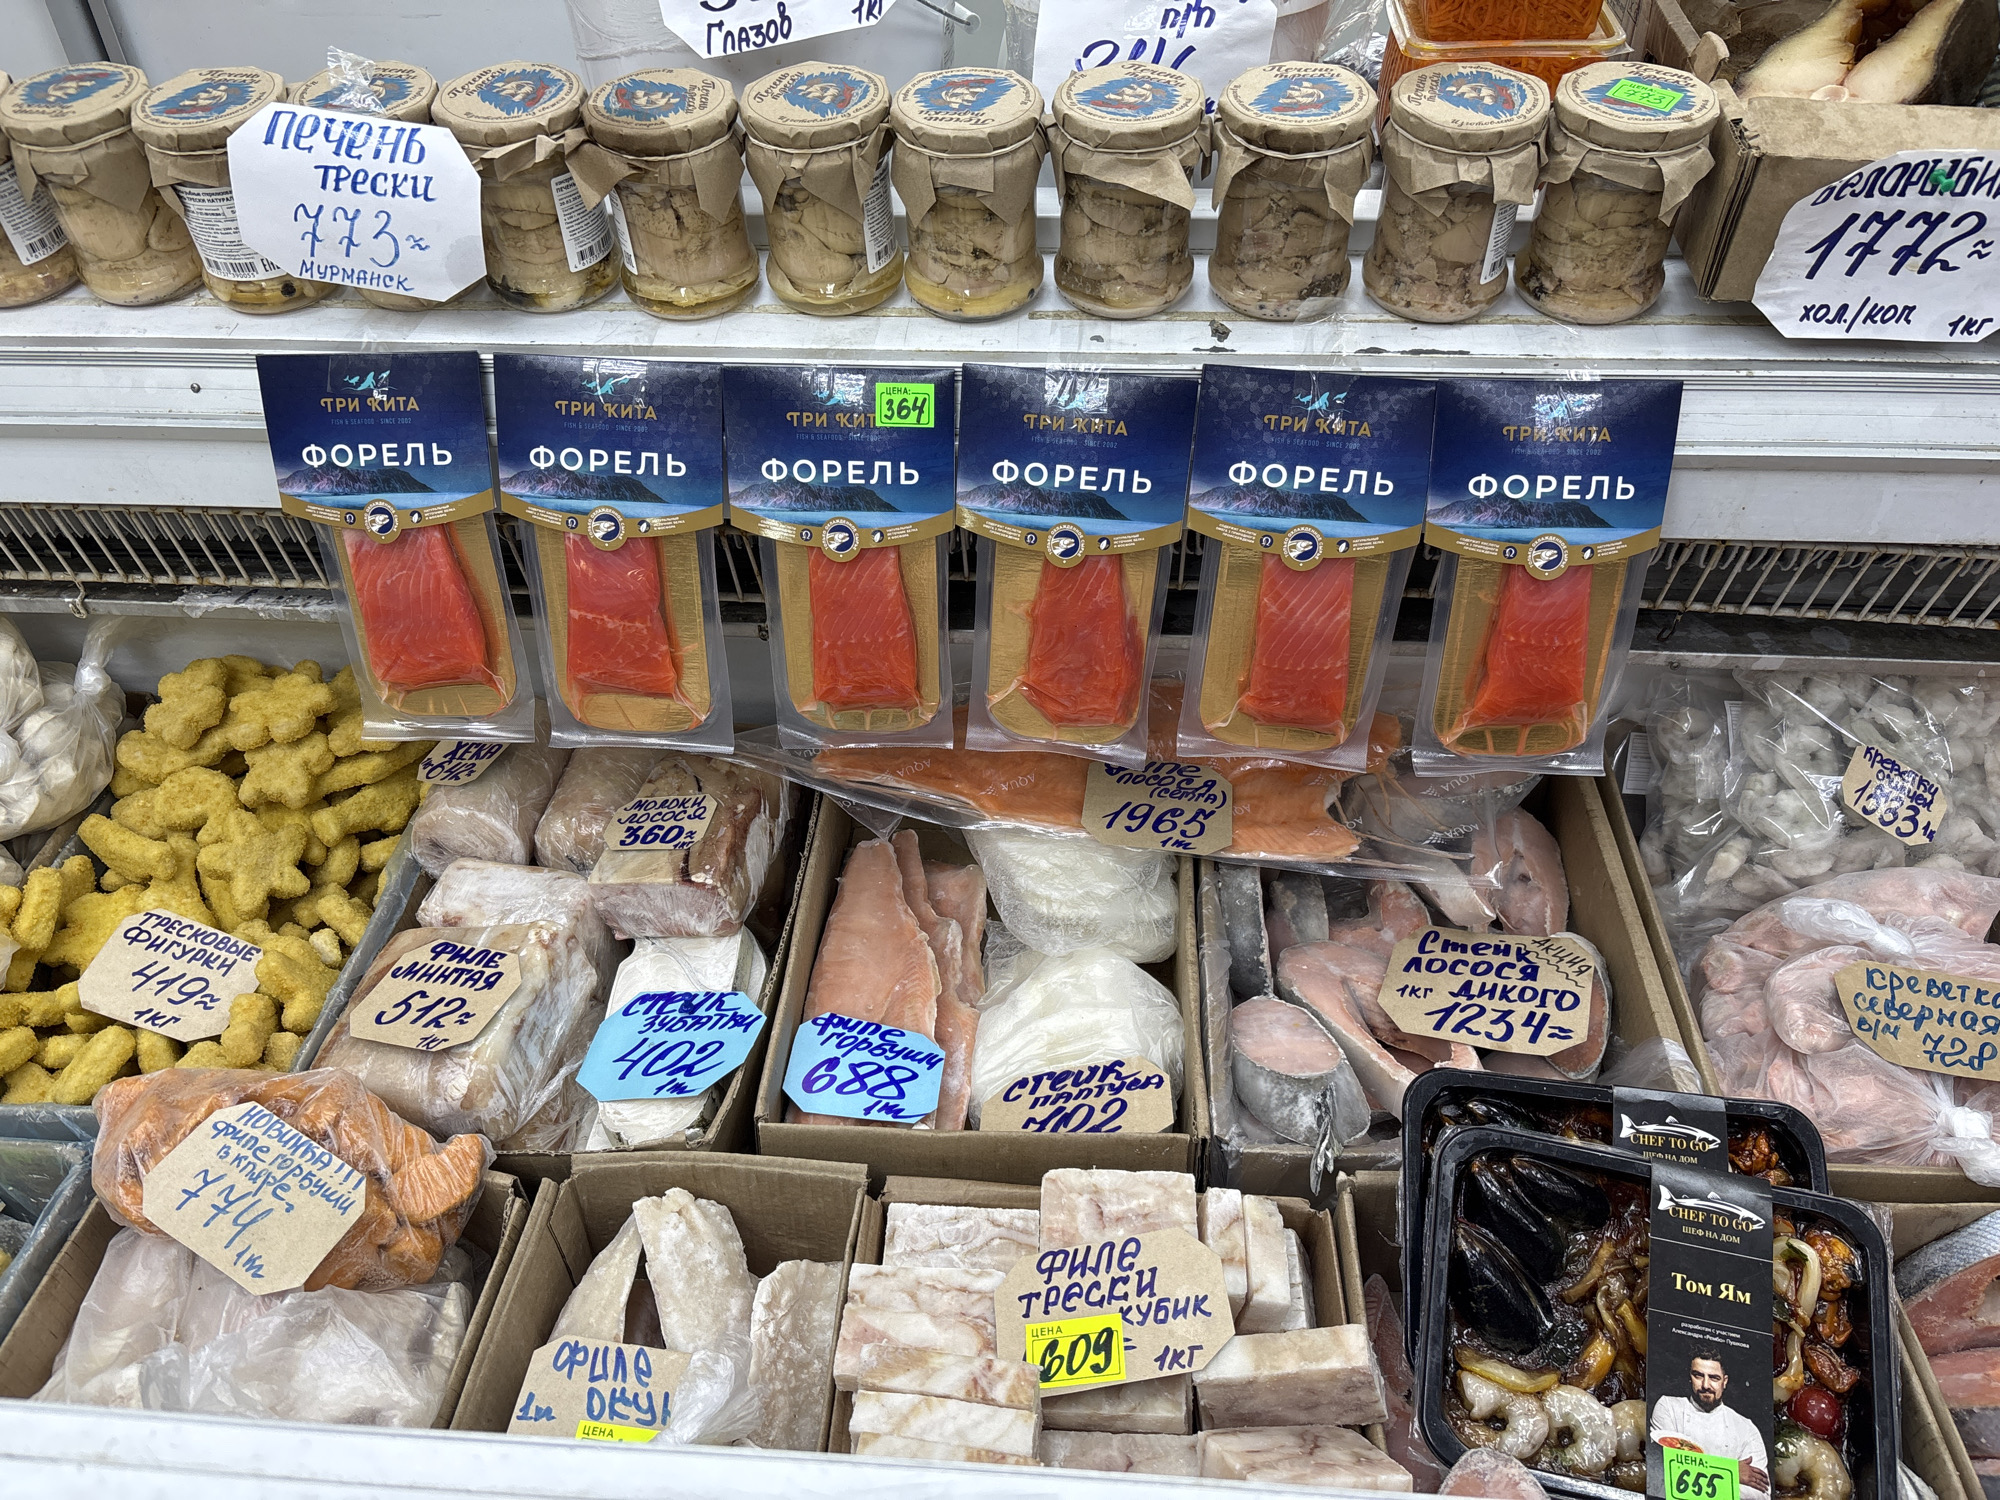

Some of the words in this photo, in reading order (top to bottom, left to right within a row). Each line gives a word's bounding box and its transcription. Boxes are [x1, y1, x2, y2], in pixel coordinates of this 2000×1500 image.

[1121, 63, 1185, 81] Печень
[1124, 71, 1188, 88] трески
[1263, 64, 1336, 74] Печень
[1273, 72, 1343, 81] трески
[1621, 63, 1694, 81] Печень
[1627, 70, 1699, 88] трески
[447, 69, 492, 98] Печень
[465, 68, 507, 97] трески
[698, 79, 716, 111] Печень
[753, 72, 790, 104] Печень
[771, 71, 805, 101] трески
[1407, 73, 1428, 106] Печень
[1426, 72, 1441, 103] трески
[685, 84, 697, 114] трески
[1624, 89, 1664, 105] 773
[885, 386, 911, 396] ЦЕНА:
[320, 397, 361, 413] ТРИ
[366, 396, 420, 413] КИТА
[555, 400, 596, 416] ТРИ
[603, 403, 658, 421] КИТА
[883, 397, 927, 425] 364
[786, 411, 828, 428] ТРИ
[835, 412, 877, 429] КИТ
[1023, 414, 1065, 431] ТРИ
[1074, 417, 1128, 437] КИТА
[1263, 414, 1308, 432] ТРИ
[1315, 418, 1372, 438] КИТА
[1502, 425, 1546, 442] ТРИ
[1555, 426, 1612, 443] КИТА
[302, 442, 453, 468] ФОРЕЛЬ
[529, 445, 687, 477] ФОРЕЛЬ
[761, 457, 920, 485] ФОРЕЛЬ
[992, 459, 1152, 494] ФОРЕЛЬ
[1228, 460, 1395, 496] ФОРЕЛЬ
[1468, 473, 1636, 500] ФОРЕЛЬ
[896, 758, 932, 777] AQUA
[1000, 773, 1036, 791] AQUA
[138, 912, 262, 962] ТРЕСКОВЫЕ
[123, 926, 238, 977] ФИГУРКИ
[430, 942, 508, 968] ФИЛЕ
[1531, 938, 1592, 977] АКЦИЯ
[391, 961, 504, 991] МИНТАЯ
[612, 1037, 725, 1080] 402
[1922, 1032, 1998, 1071] 728
[802, 1056, 919, 1100] 688
[1630, 1134, 1666, 1147] CHEF
[1669, 1137, 1687, 1149] TO
[1690, 1140, 1710, 1153] GO
[1665, 1153, 1677, 1162] НА
[1678, 1155, 1698, 1164] ДОМ
[175, 1169, 274, 1249] 774
[1669, 1207, 1707, 1222] CHEF
[1710, 1213, 1729, 1228] TO
[1732, 1218, 1753, 1233] GO
[1682, 1226, 1704, 1237] ШЕФ
[1705, 1229, 1718, 1240] НА
[1719, 1232, 1741, 1245] ДОМ
[1671, 1272, 1713, 1297] Том
[1718, 1283, 1752, 1305] Ям
[1031, 1325, 1063, 1339] ЦЕНА
[1671, 1327, 1703, 1339] Александра
[1726, 1338, 1750, 1349] Пушкова
[1680, 1322, 1711, 1333] разработан
[1716, 1329, 1741, 1338] участием
[1039, 1326, 1114, 1383] 609
[582, 1424, 614, 1439] ЦЕНА
[1676, 1453, 1708, 1468] ЦЕНА:
[1676, 1469, 1724, 1498] 655
